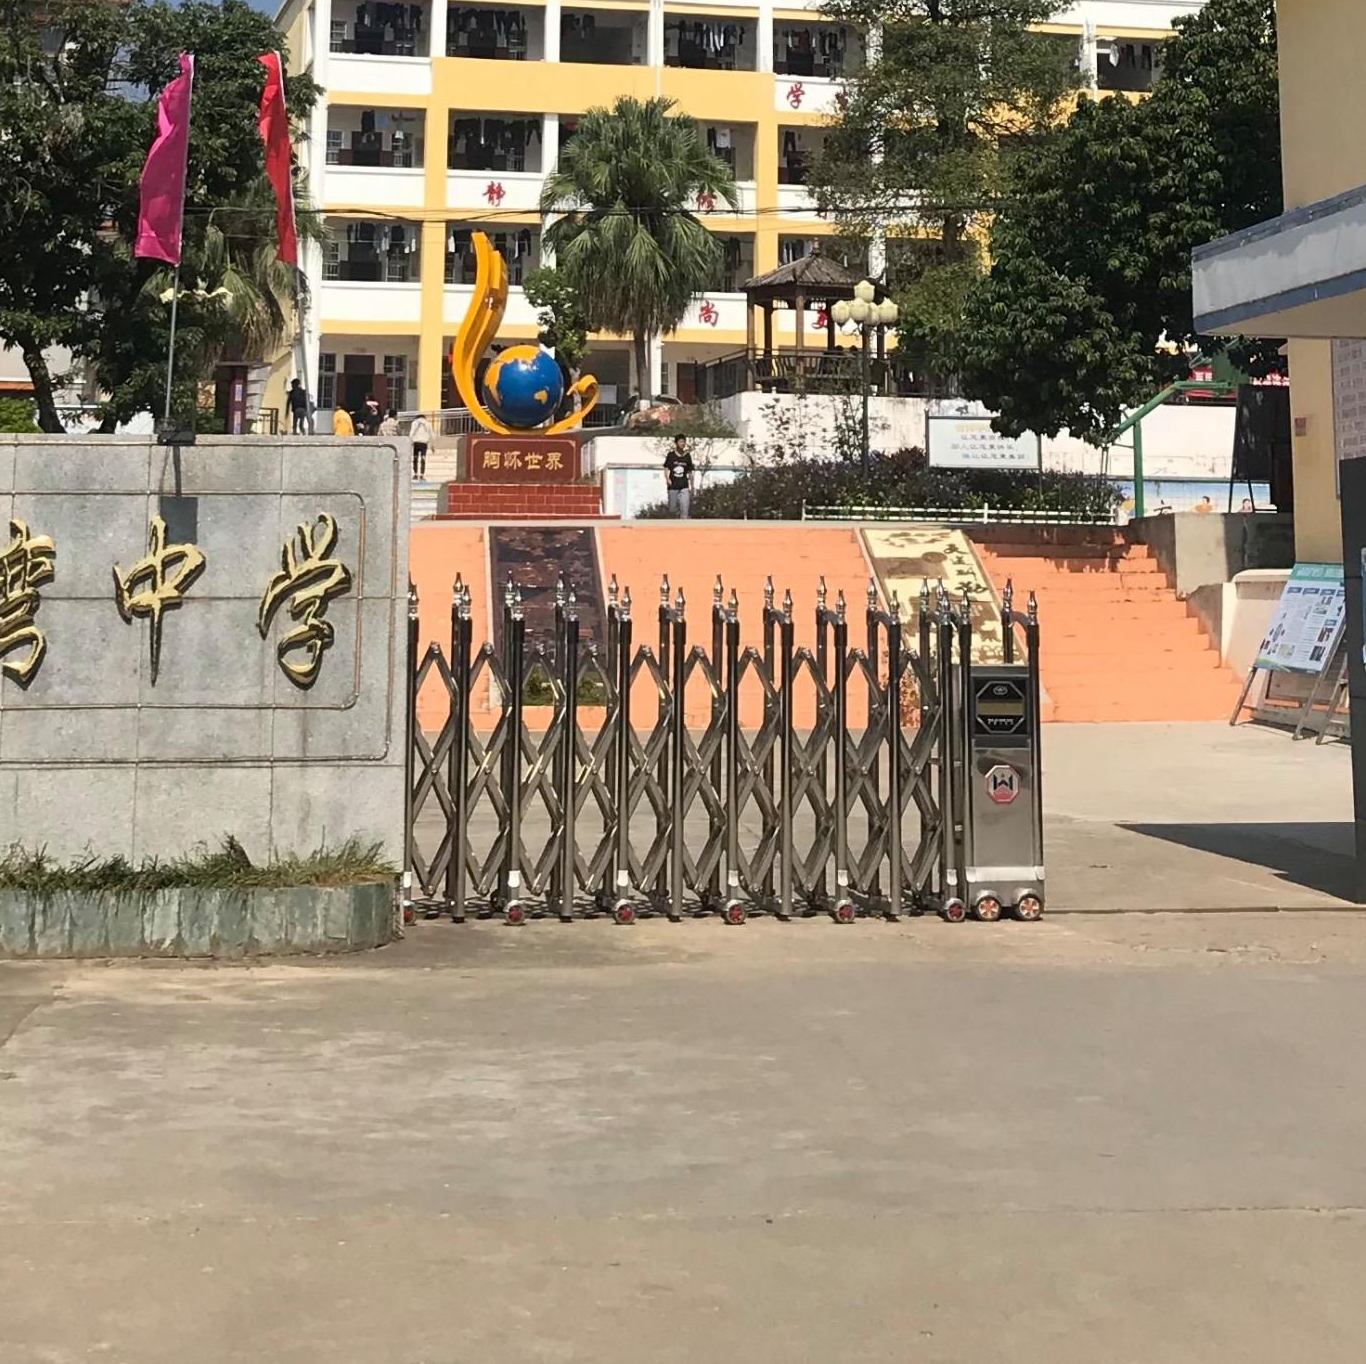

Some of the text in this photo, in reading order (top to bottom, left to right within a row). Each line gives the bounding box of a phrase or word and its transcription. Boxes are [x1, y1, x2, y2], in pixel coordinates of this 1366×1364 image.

[786, 81, 805, 109] 学
[482, 181, 506, 207] 静
[698, 301, 720, 327] 尚
[483, 450, 564, 470] 胸怀世界
